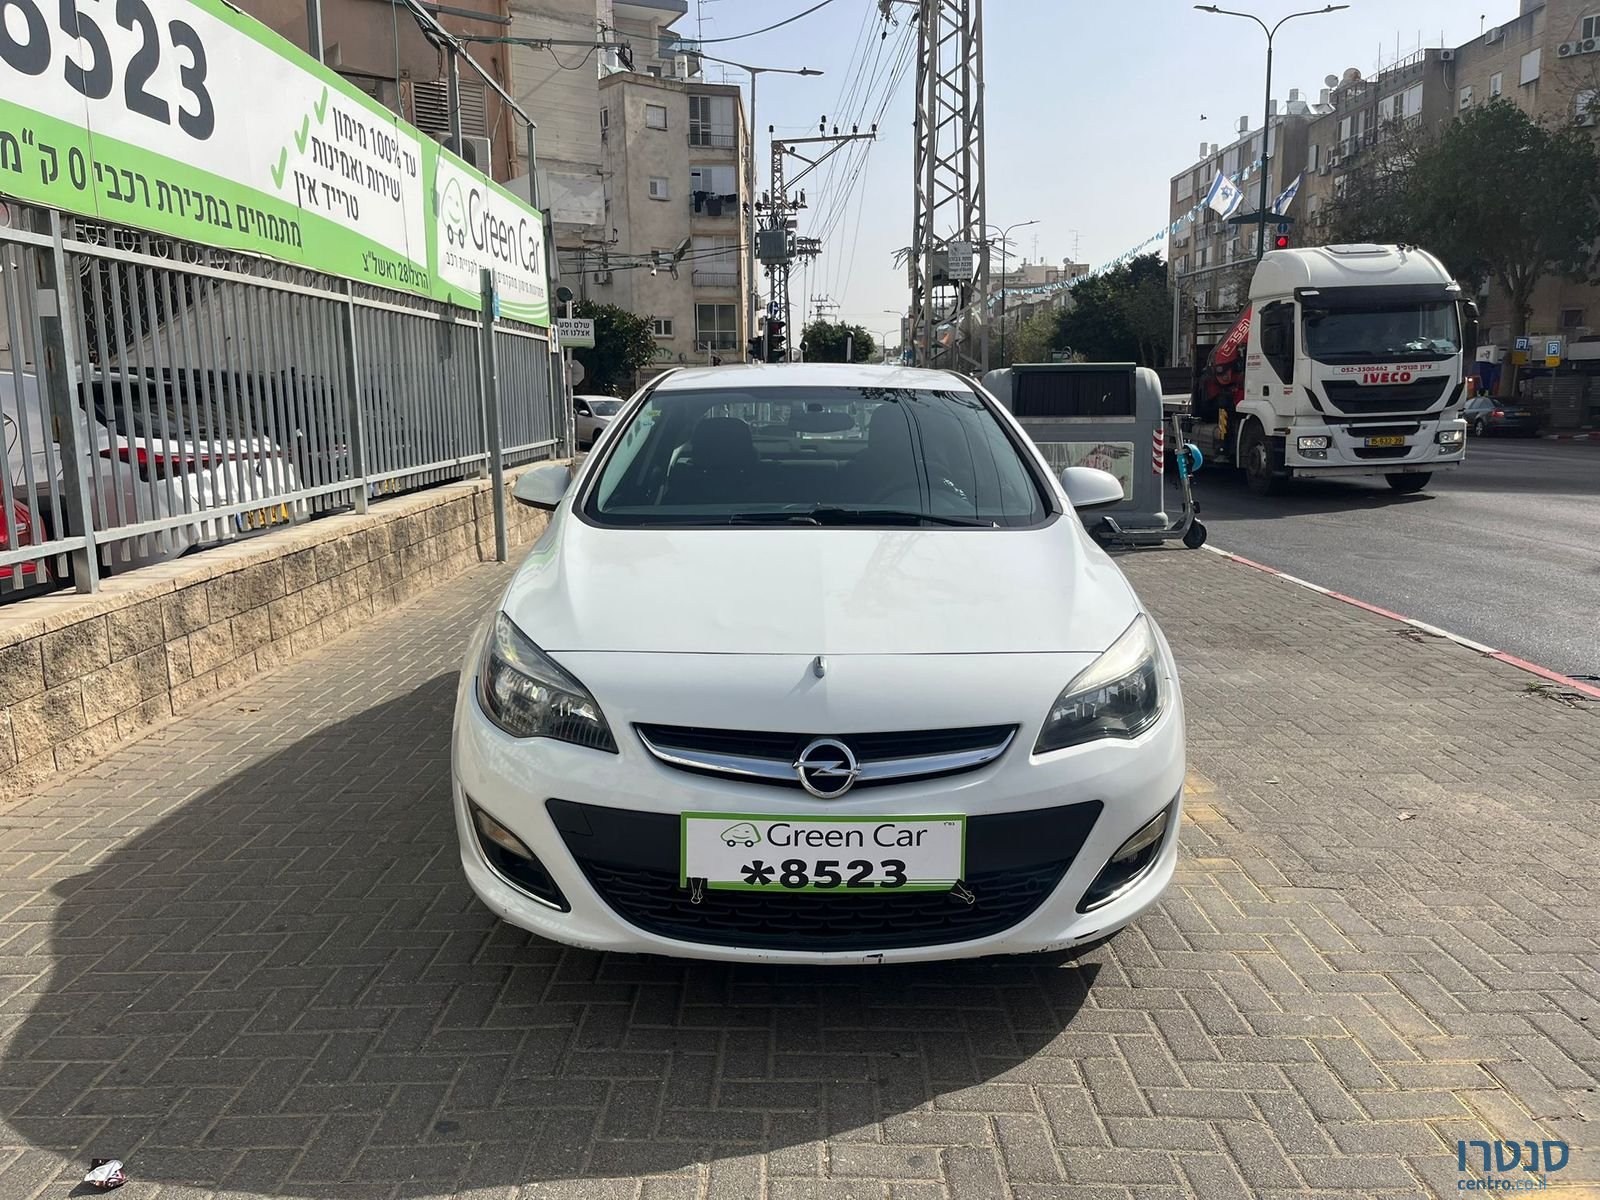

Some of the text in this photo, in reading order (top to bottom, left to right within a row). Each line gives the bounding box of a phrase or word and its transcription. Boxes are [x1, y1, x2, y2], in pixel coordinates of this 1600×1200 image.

[332, 106, 417, 178] עד 100% מימון
[68, 146, 87, 191] 0
[93, 161, 151, 208] רכבי
[311, 136, 400, 203] שירות ואמינות
[155, 179, 233, 230] במכירת
[294, 170, 359, 221] טרייד אין
[236, 204, 302, 247] מתמחים
[468, 188, 540, 275] Green Car
[398, 261, 409, 284] 28
[409, 264, 429, 289] הרצל
[574, 321, 590, 329] שלם
[1363, 372, 1411, 383] IVECO
[766, 823, 928, 848] Green Car
